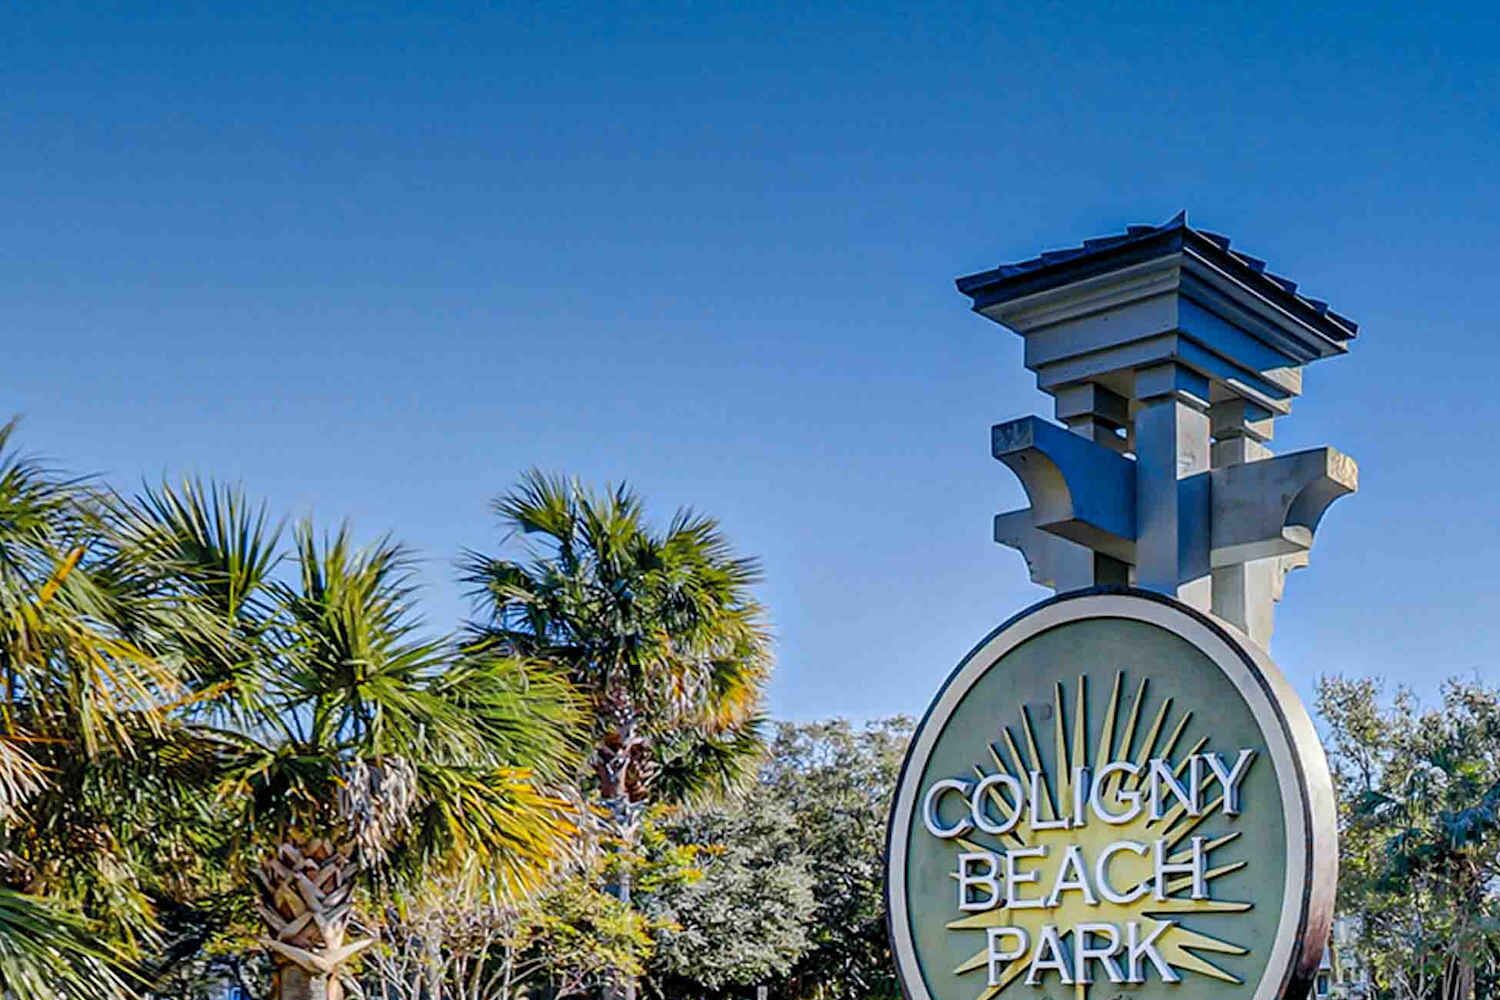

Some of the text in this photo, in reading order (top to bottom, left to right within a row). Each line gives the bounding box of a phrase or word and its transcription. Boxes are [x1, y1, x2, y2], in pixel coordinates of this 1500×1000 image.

[923, 748, 1257, 839] COLIGNY
[957, 836, 1210, 912] BEACH
[985, 920, 1180, 987] PARK
